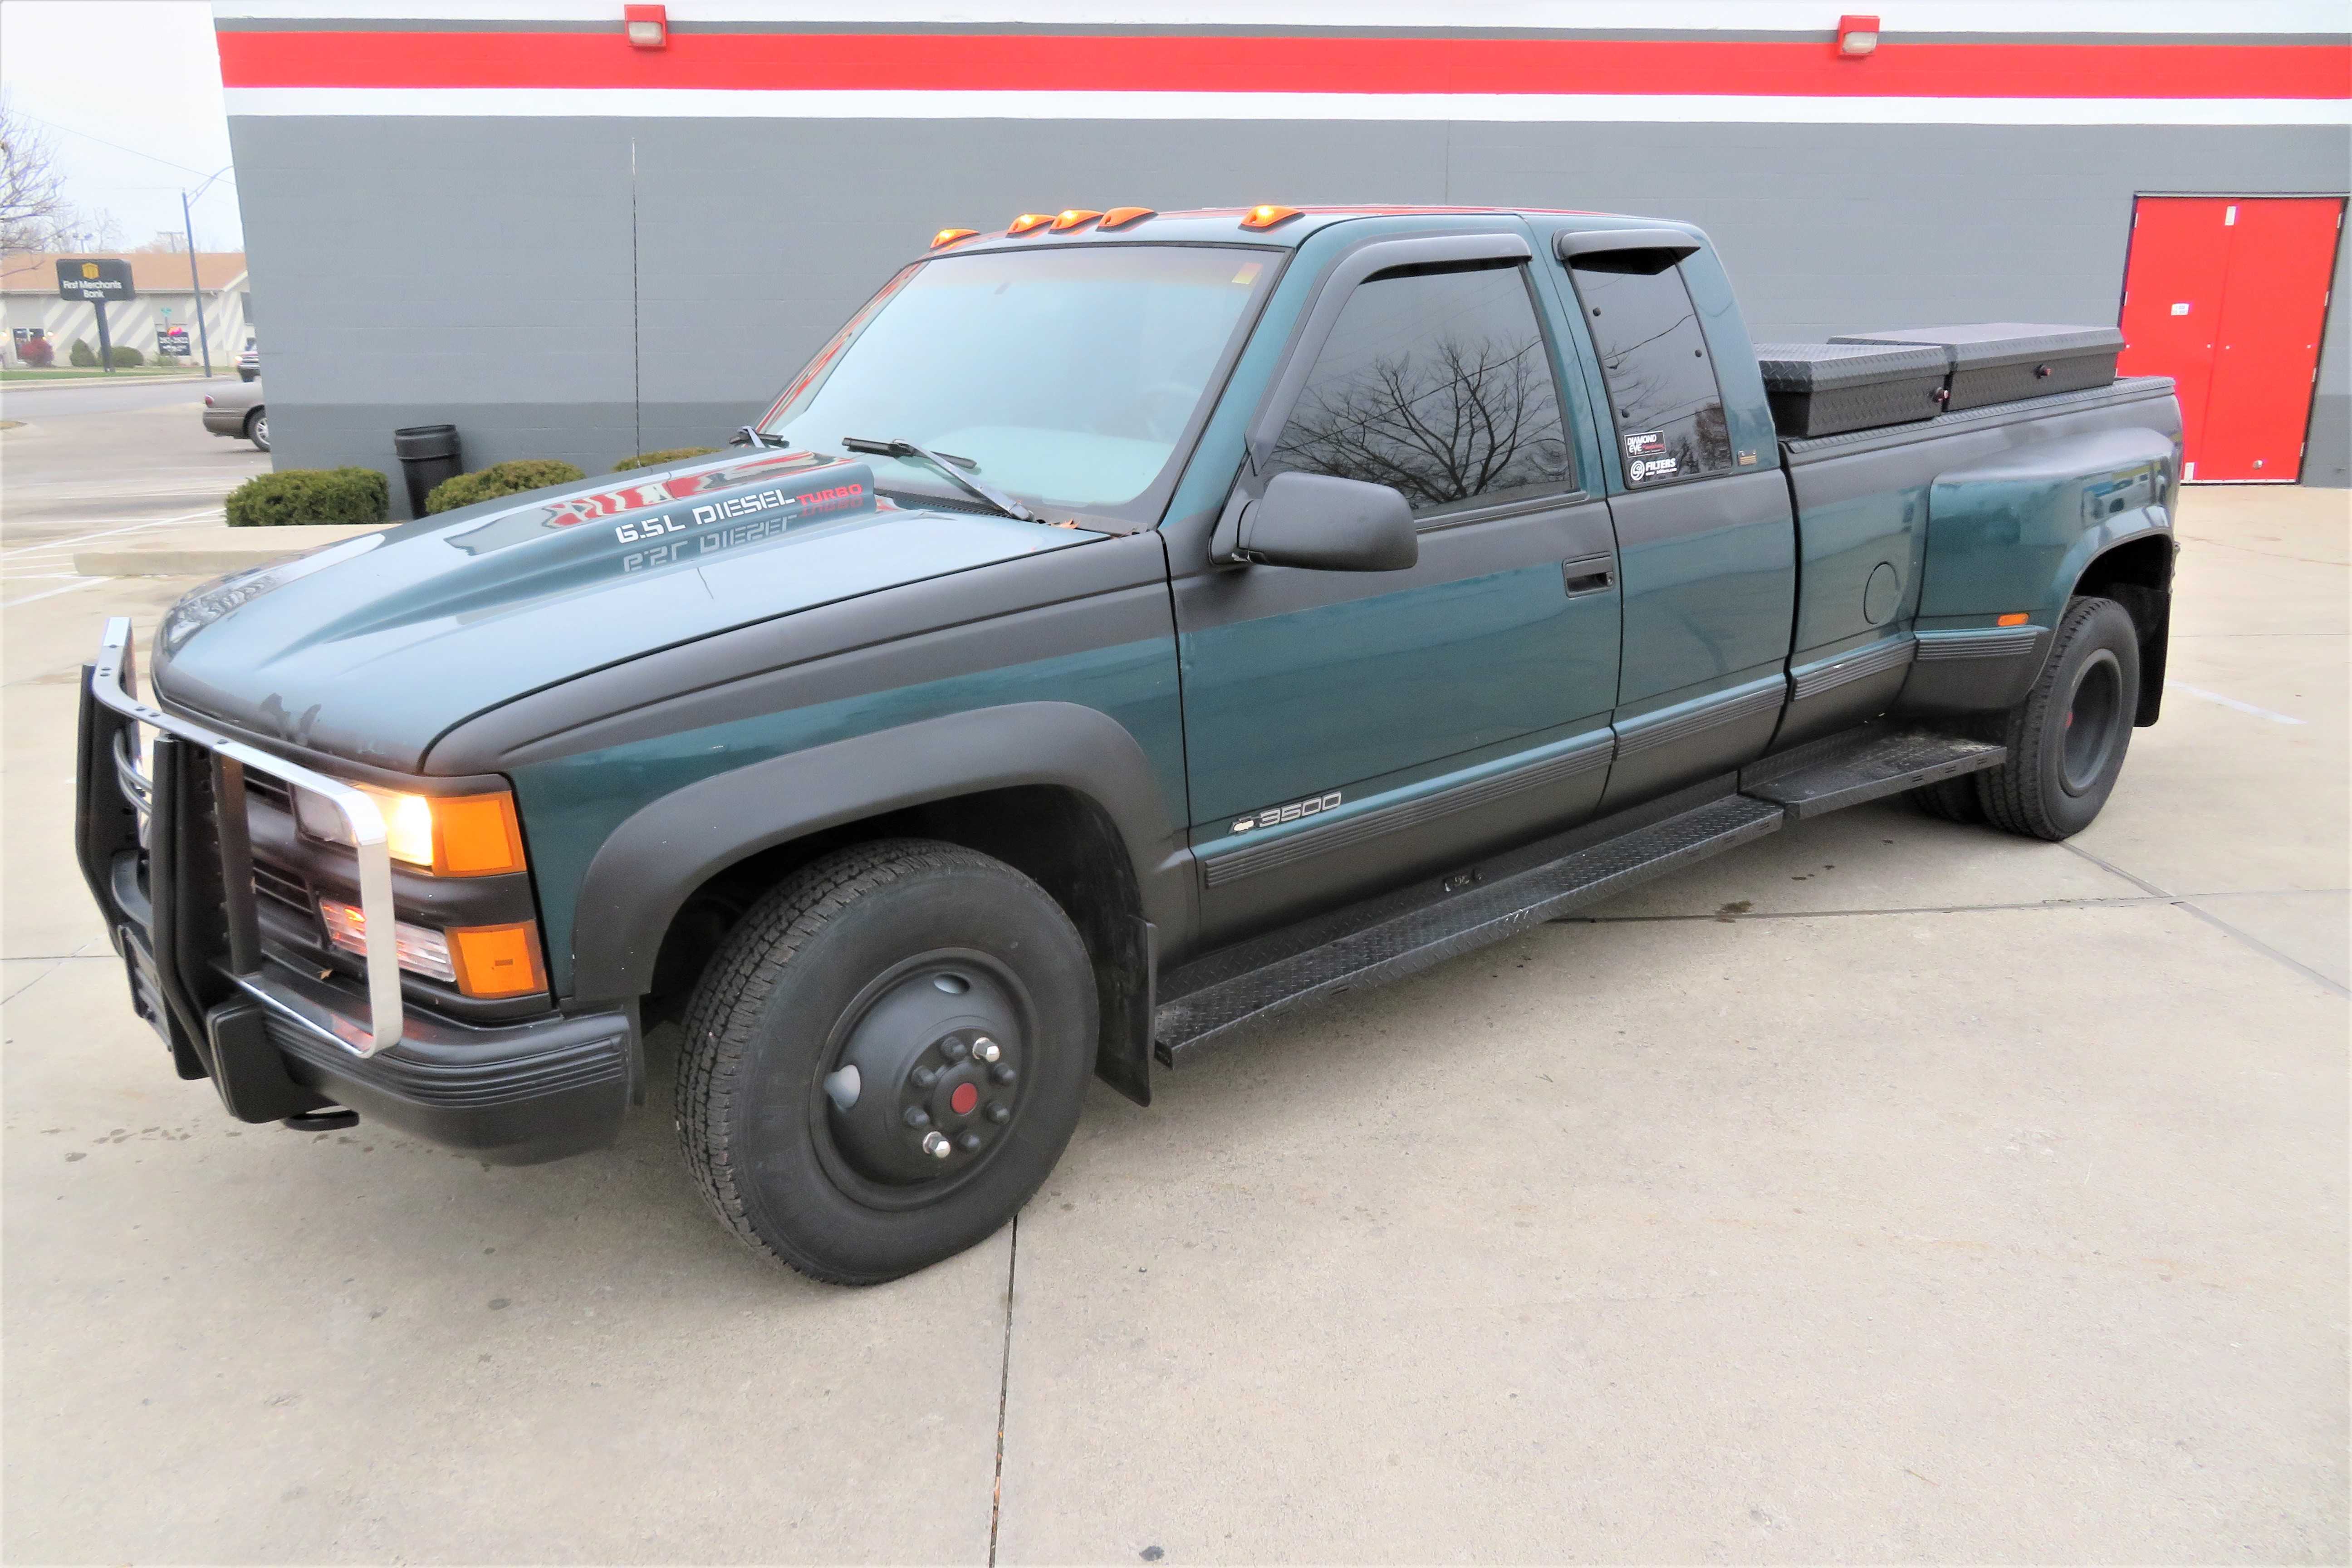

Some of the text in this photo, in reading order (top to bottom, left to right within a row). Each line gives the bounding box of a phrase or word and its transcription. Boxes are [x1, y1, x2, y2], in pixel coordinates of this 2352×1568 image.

[63, 280, 122, 289] First Merchants
[83, 289, 105, 298] Bank
[1627, 434, 1657, 446] DIAMOND
[1646, 458, 1676, 471] FILTERS
[615, 483, 863, 544] 6.5L DIESEL TURBO
[1259, 791, 1342, 828] 3500
